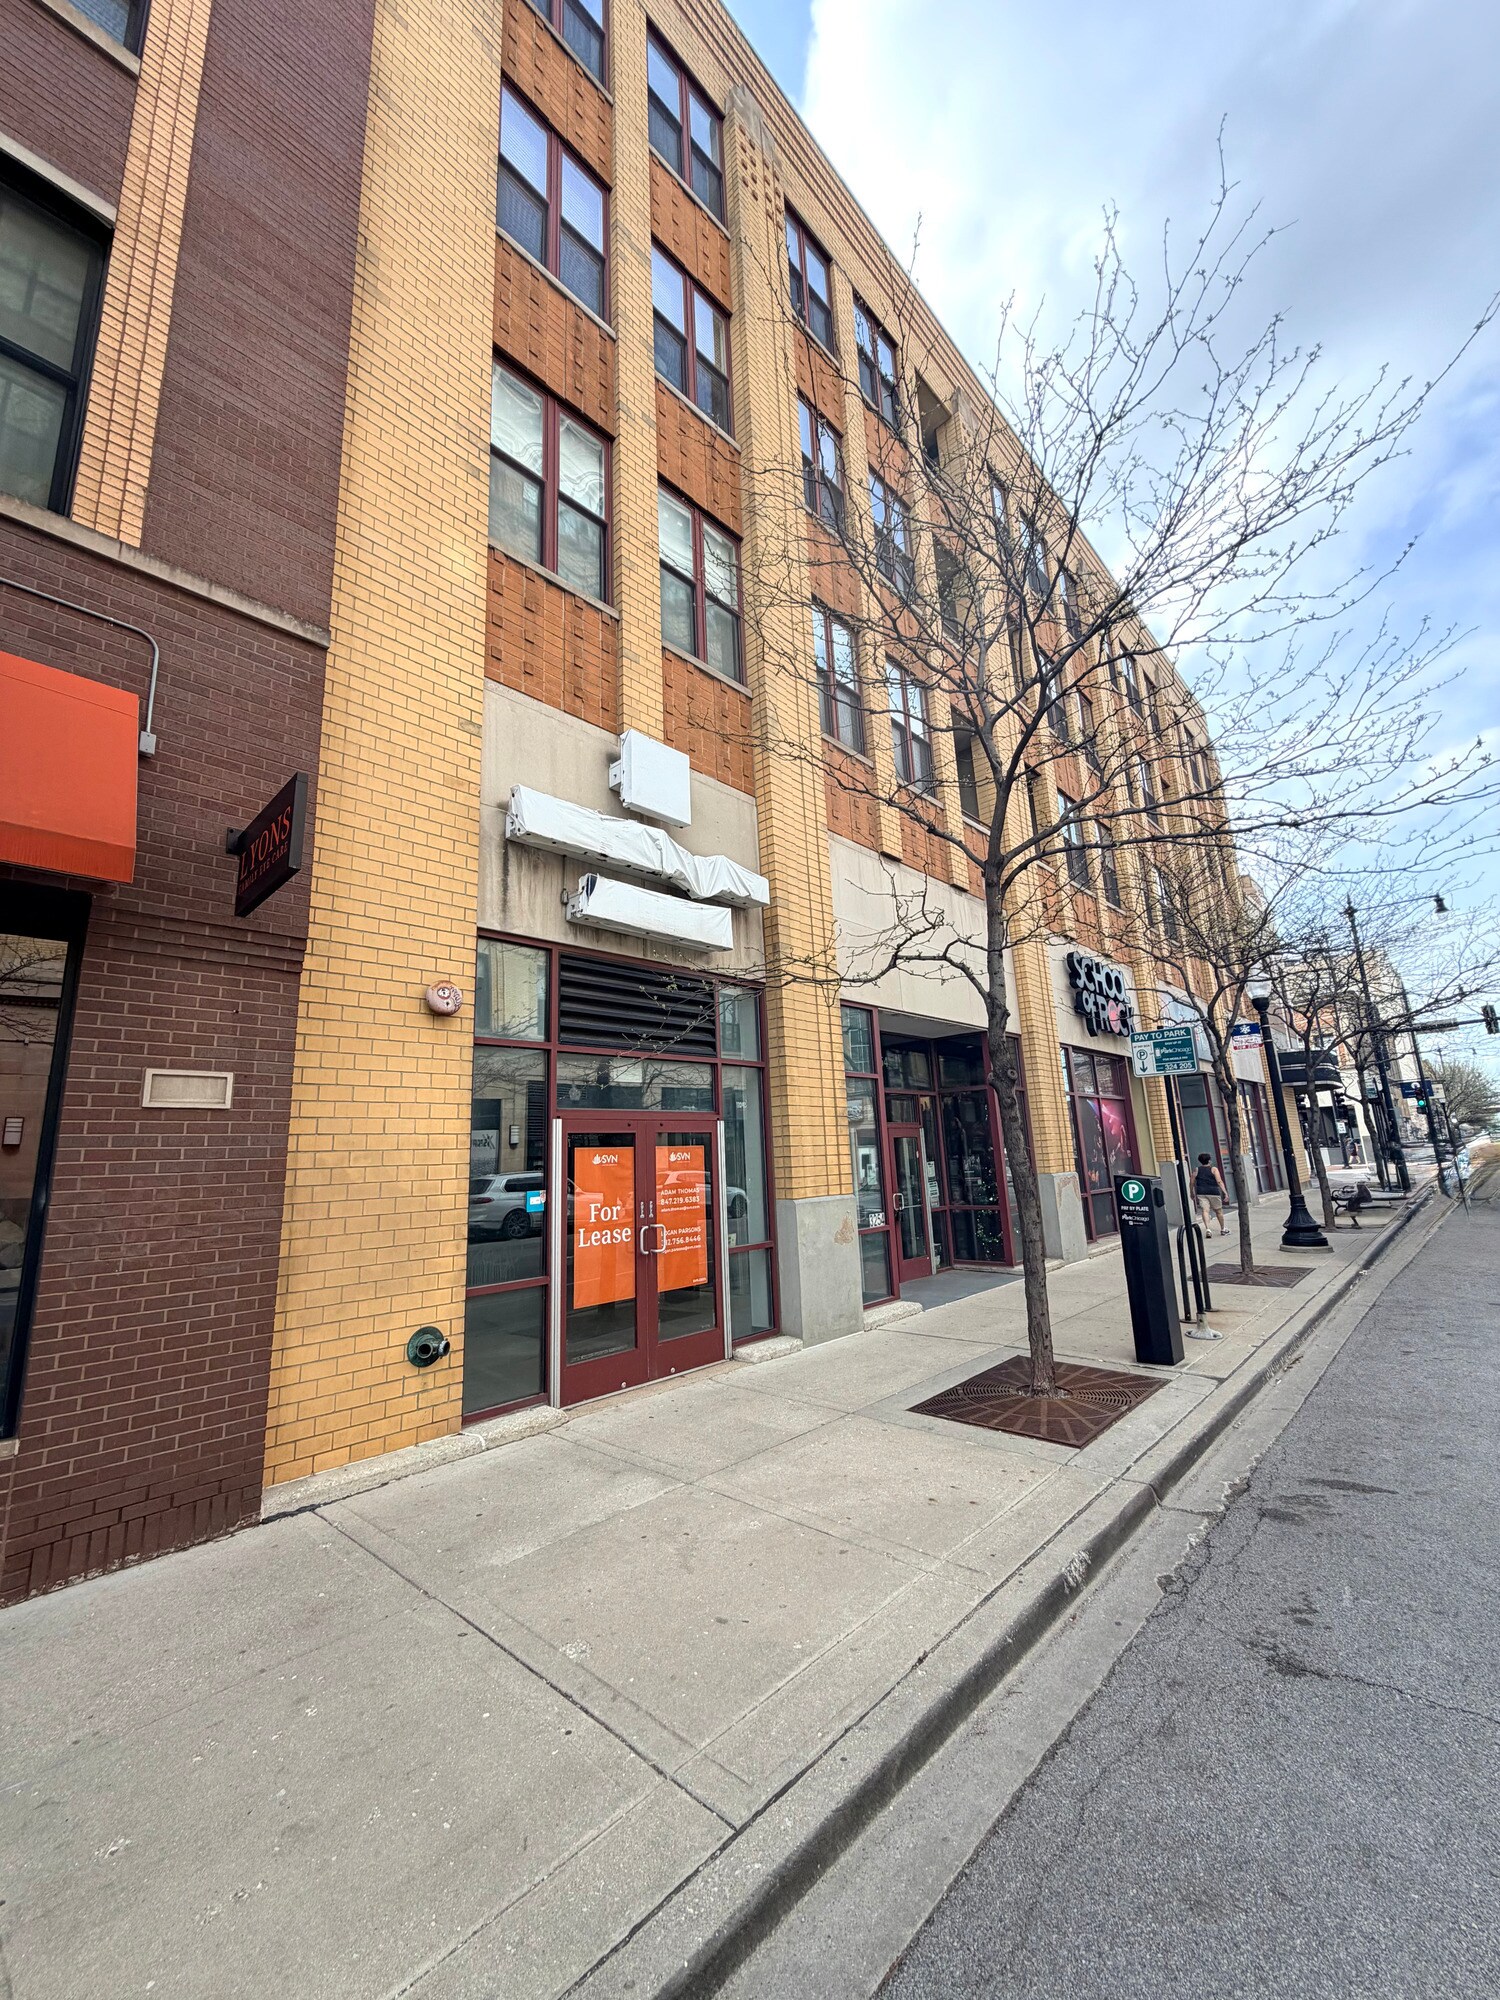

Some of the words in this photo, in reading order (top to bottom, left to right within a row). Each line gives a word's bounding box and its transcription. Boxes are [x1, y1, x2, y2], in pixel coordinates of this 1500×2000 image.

[240, 806, 292, 880] LYONS
[259, 858, 271, 877] EYE
[272, 841, 289, 864] CARE
[1068, 951, 1130, 1004] SCHOOL
[1097, 997, 1136, 1036] ROCK
[1164, 1029, 1186, 1038] PARK
[602, 1154, 618, 1164] SVN
[676, 1152, 691, 1161] SVN
[1128, 1184, 1139, 1198] P
[660, 1196, 700, 1205] 847.219.6383
[589, 1203, 620, 1223] For
[870, 1214, 884, 1226] 3254
[678, 1226, 701, 1234] PARSONS
[578, 1227, 632, 1248] Lease
